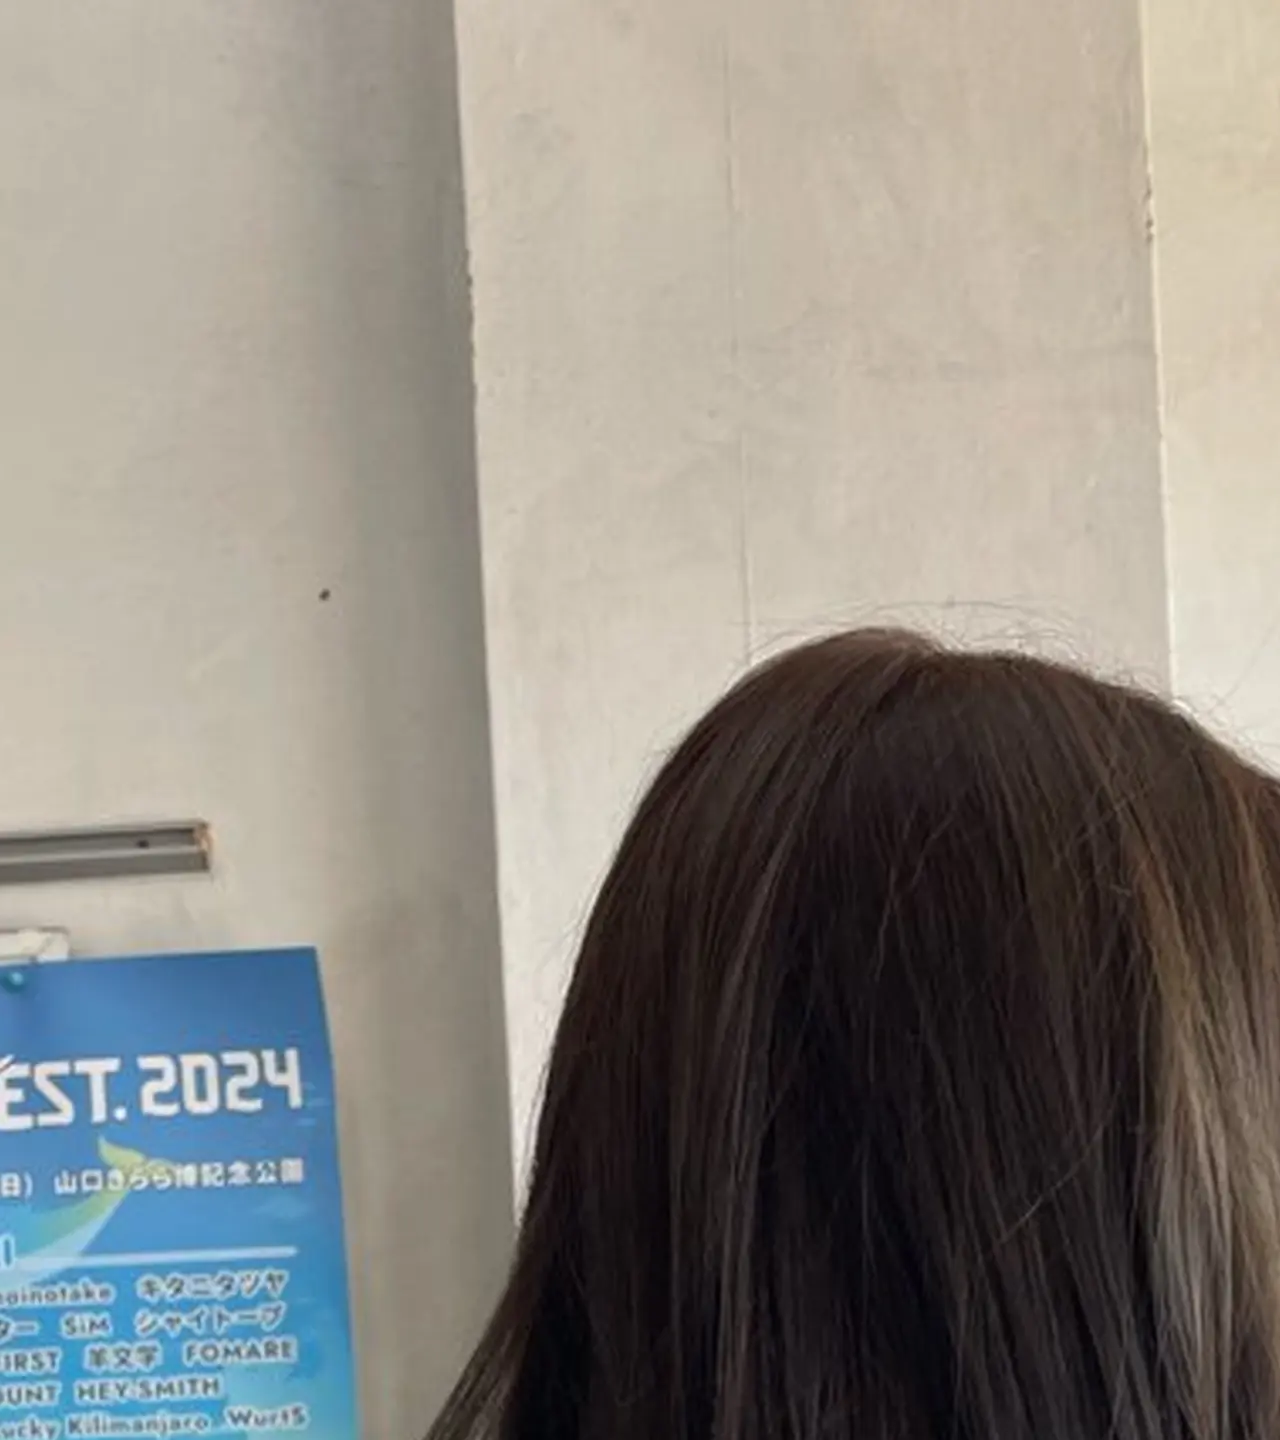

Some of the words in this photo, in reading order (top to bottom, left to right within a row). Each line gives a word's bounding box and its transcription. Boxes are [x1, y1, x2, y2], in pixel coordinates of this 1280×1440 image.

[136, 1047, 303, 1117] 2024
[137, 1270, 287, 1299] キタニタツヤ
[86, 1343, 160, 1371] 羊文学
[184, 1338, 296, 1367] FOMARE
[224, 1403, 306, 1430] WurtS
